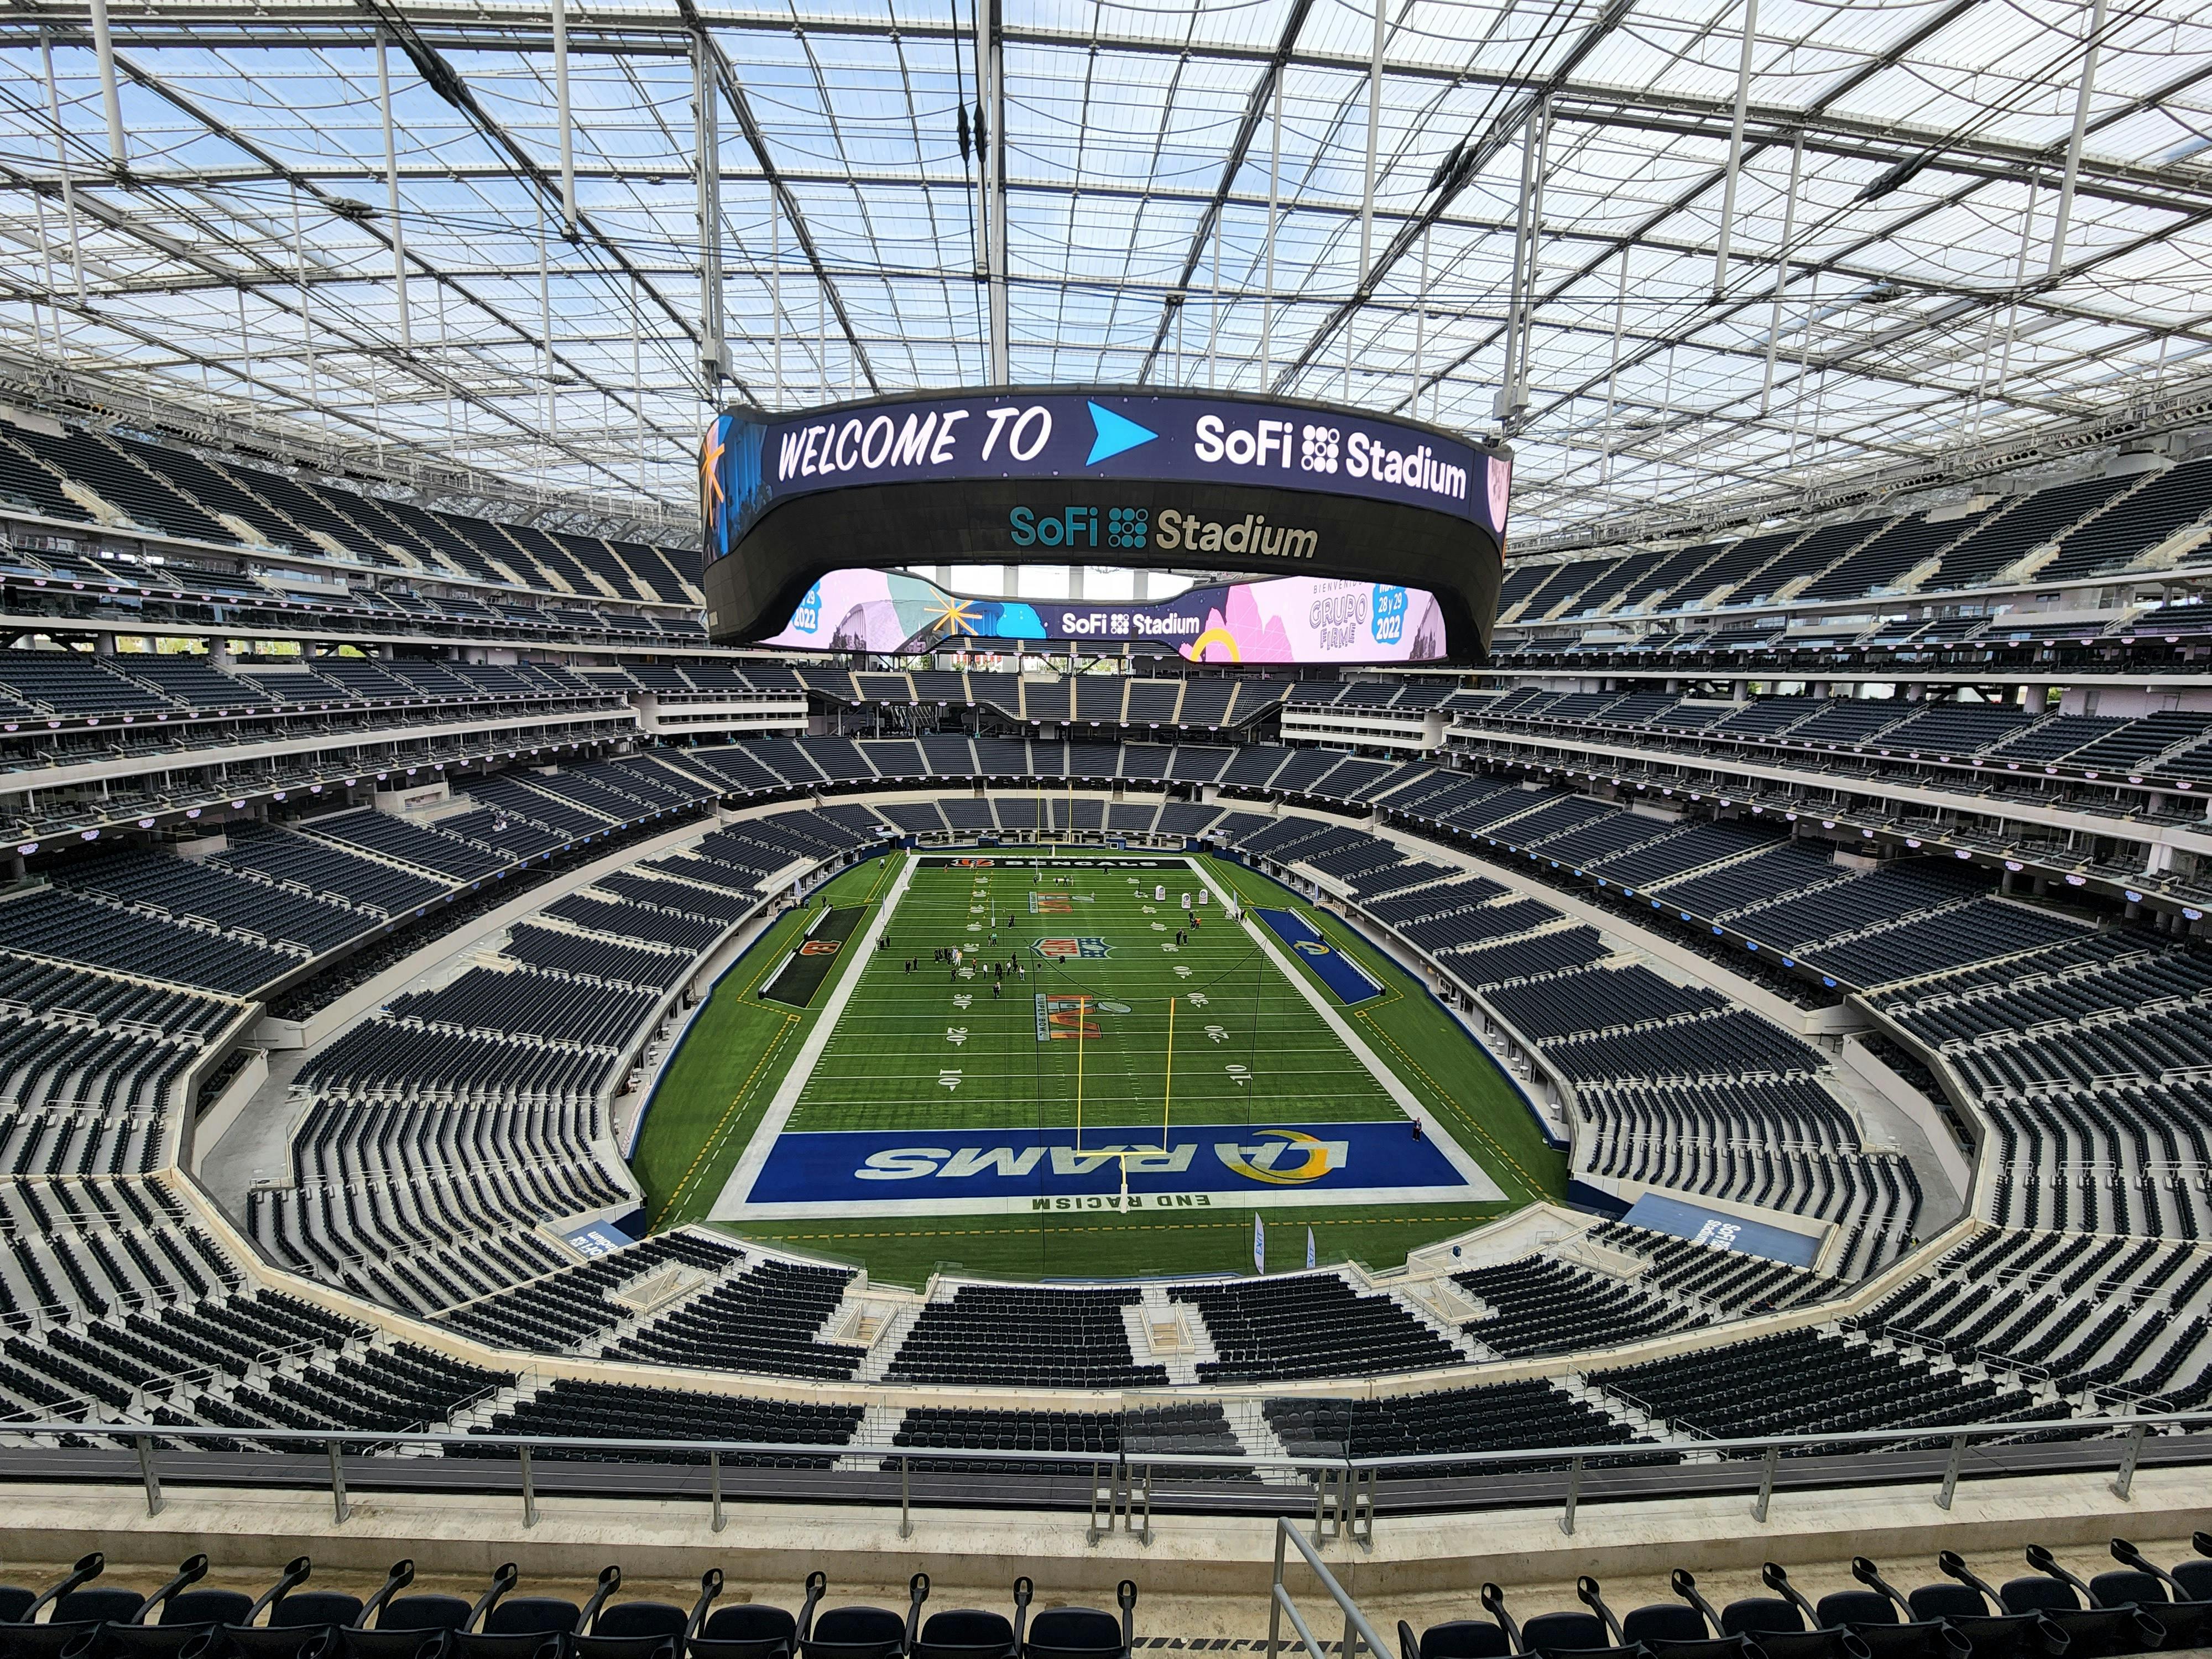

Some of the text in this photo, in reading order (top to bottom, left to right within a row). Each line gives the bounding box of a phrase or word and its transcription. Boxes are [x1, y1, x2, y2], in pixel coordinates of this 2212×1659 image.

[778, 405, 1053, 481] WELCOME TO
[1194, 415, 1467, 499] SoFi Stadium
[1010, 506, 1318, 558] SoFi Stadium
[1310, 593, 1368, 629] GRUPO
[1379, 597, 1387, 613] 28
[1394, 592, 1402, 610] 29
[794, 607, 816, 629] 2022
[1062, 612, 1199, 635] SoFi Stadium
[1376, 615, 1401, 640] 2022
[1320, 622, 1357, 650] FIRME
[946, 1027, 968, 1041] 20
[1204, 1025, 1229, 1039] 20
[938, 1068, 963, 1086] 10
[1225, 1065, 1253, 1081] 10
[854, 1143, 1198, 1180] RAMS
[1032, 1194, 1211, 1210] END RACISM
[578, 1243, 603, 1255] oFi
